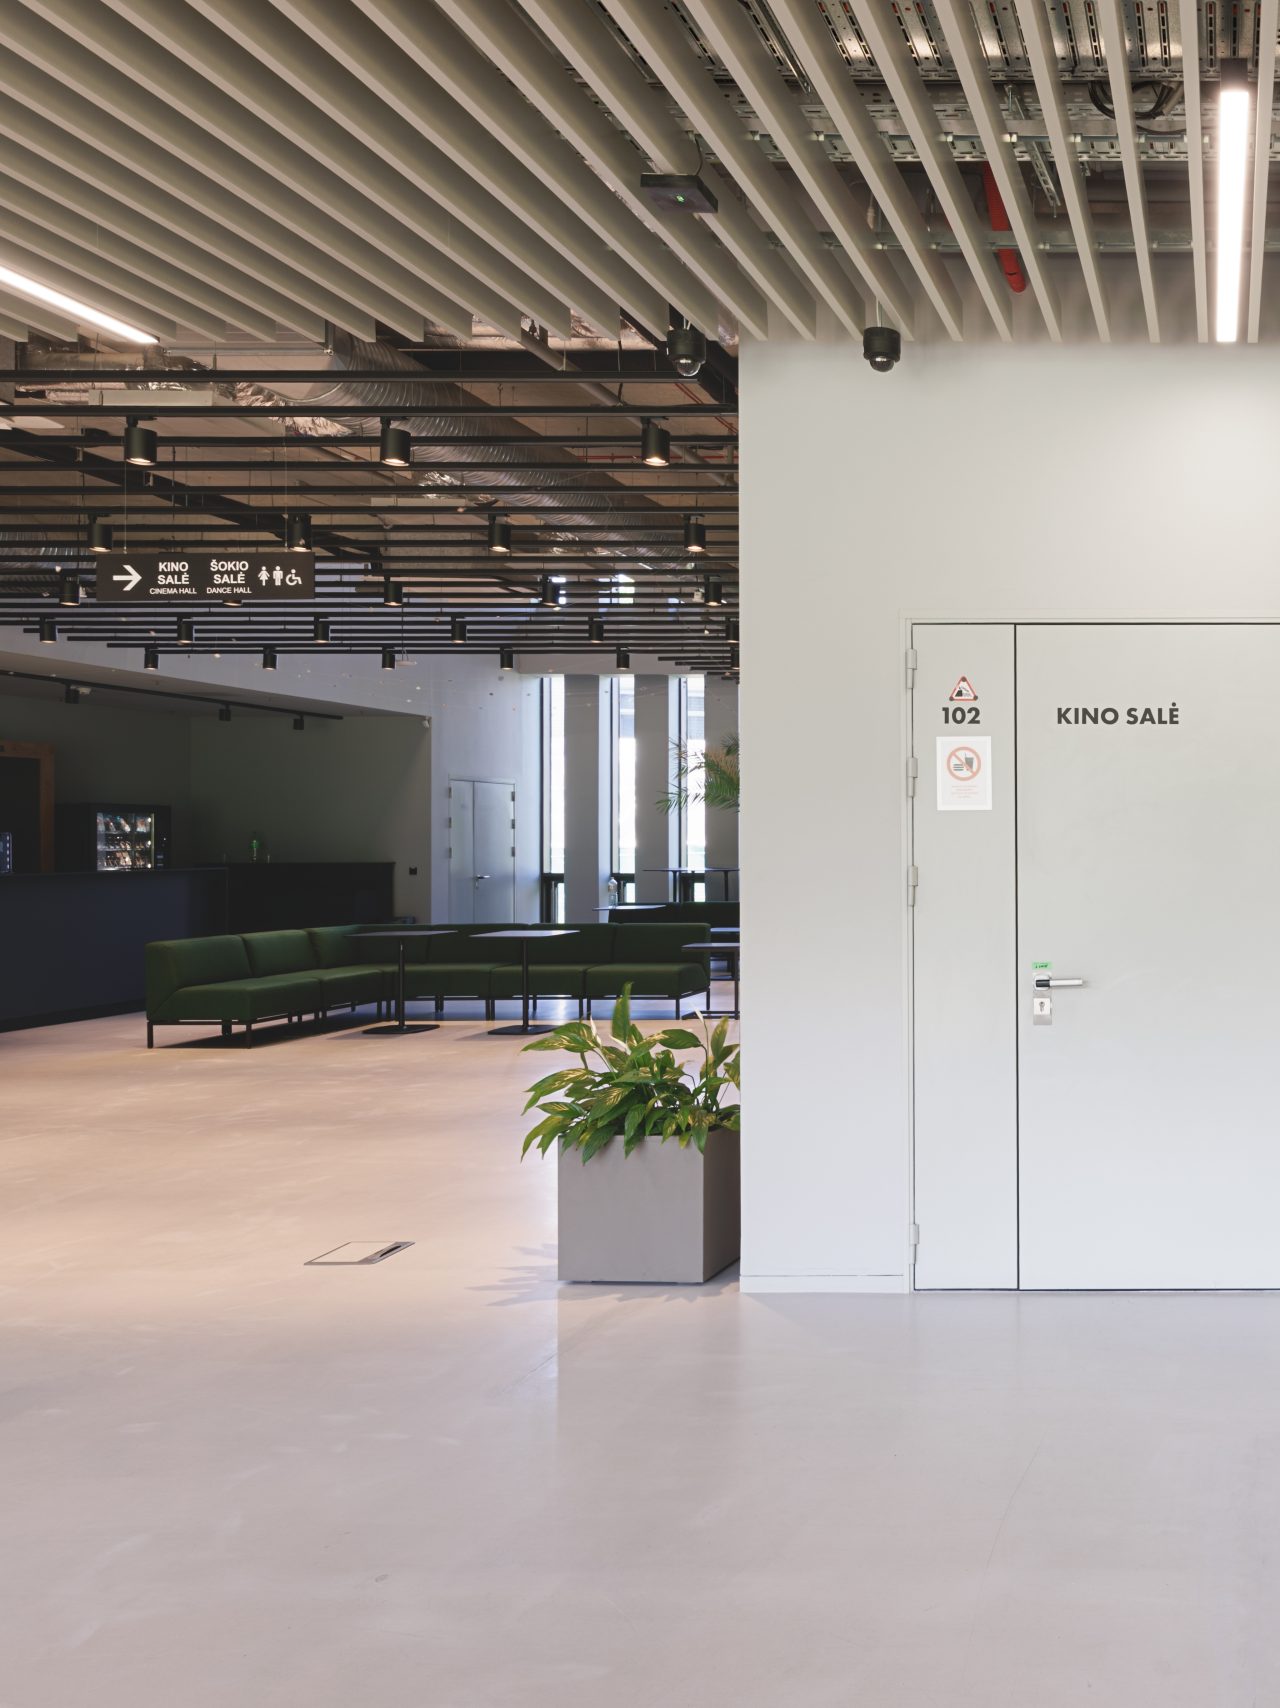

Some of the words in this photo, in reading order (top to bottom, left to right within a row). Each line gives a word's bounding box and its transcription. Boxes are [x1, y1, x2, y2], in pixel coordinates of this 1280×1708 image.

[158, 561, 189, 572] KINO
[210, 559, 249, 571] ŠOKIO
[157, 573, 190, 585] SALĖ
[213, 572, 246, 584] SALĖ
[149, 587, 179, 595] CINEMA
[206, 587, 231, 595] DANCE
[233, 586, 252, 594] HALL
[942, 706, 981, 725] 102
[1057, 707, 1119, 725] KINO
[1126, 702, 1180, 725] SALĖ
